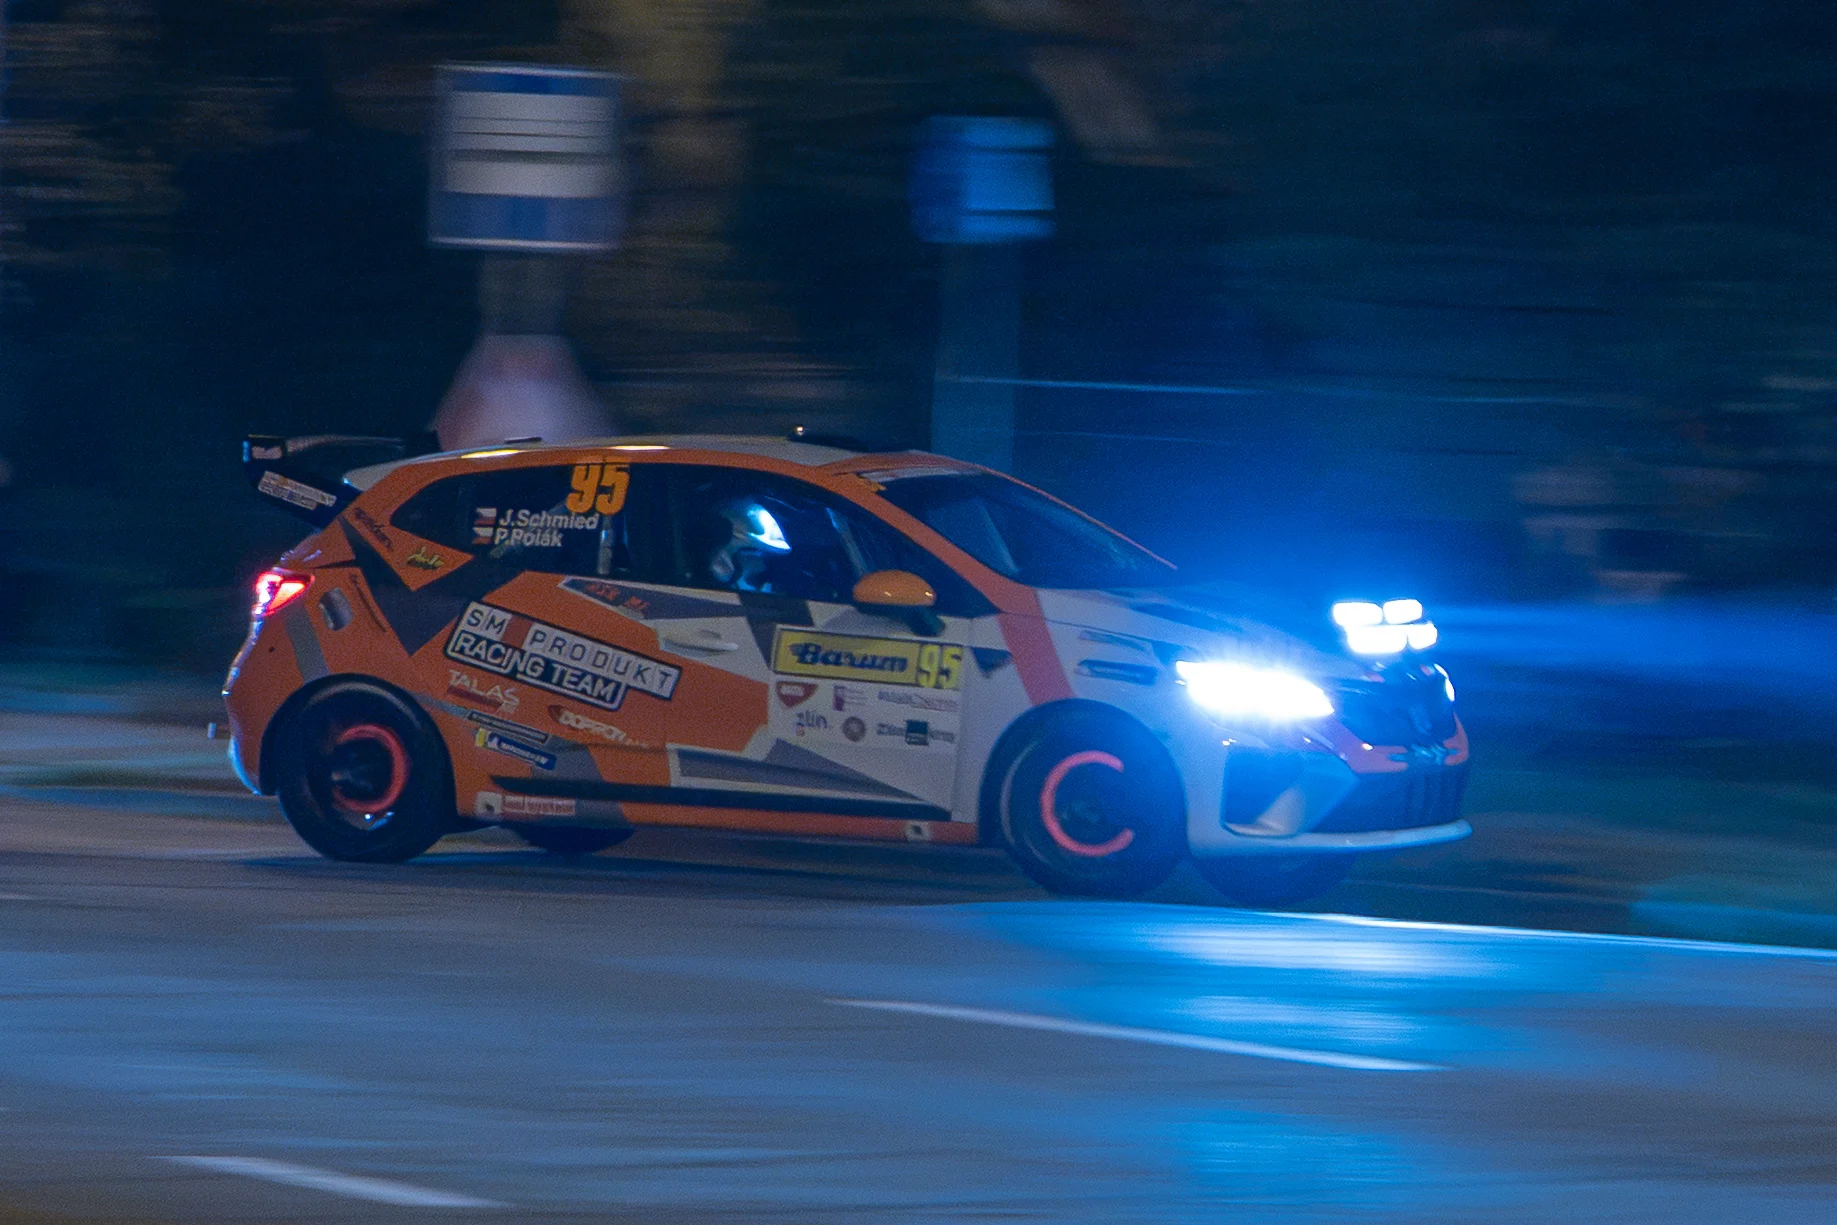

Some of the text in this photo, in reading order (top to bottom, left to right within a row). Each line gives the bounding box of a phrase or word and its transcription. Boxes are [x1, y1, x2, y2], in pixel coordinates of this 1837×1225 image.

[565, 457, 631, 516] 95
[500, 508, 600, 531] J.Schmied
[466, 608, 507, 635] SM
[453, 631, 618, 703] RACING TEAM
[529, 630, 673, 690] PRODUKT
[916, 644, 964, 690] 95
[448, 668, 521, 706] TALAS
